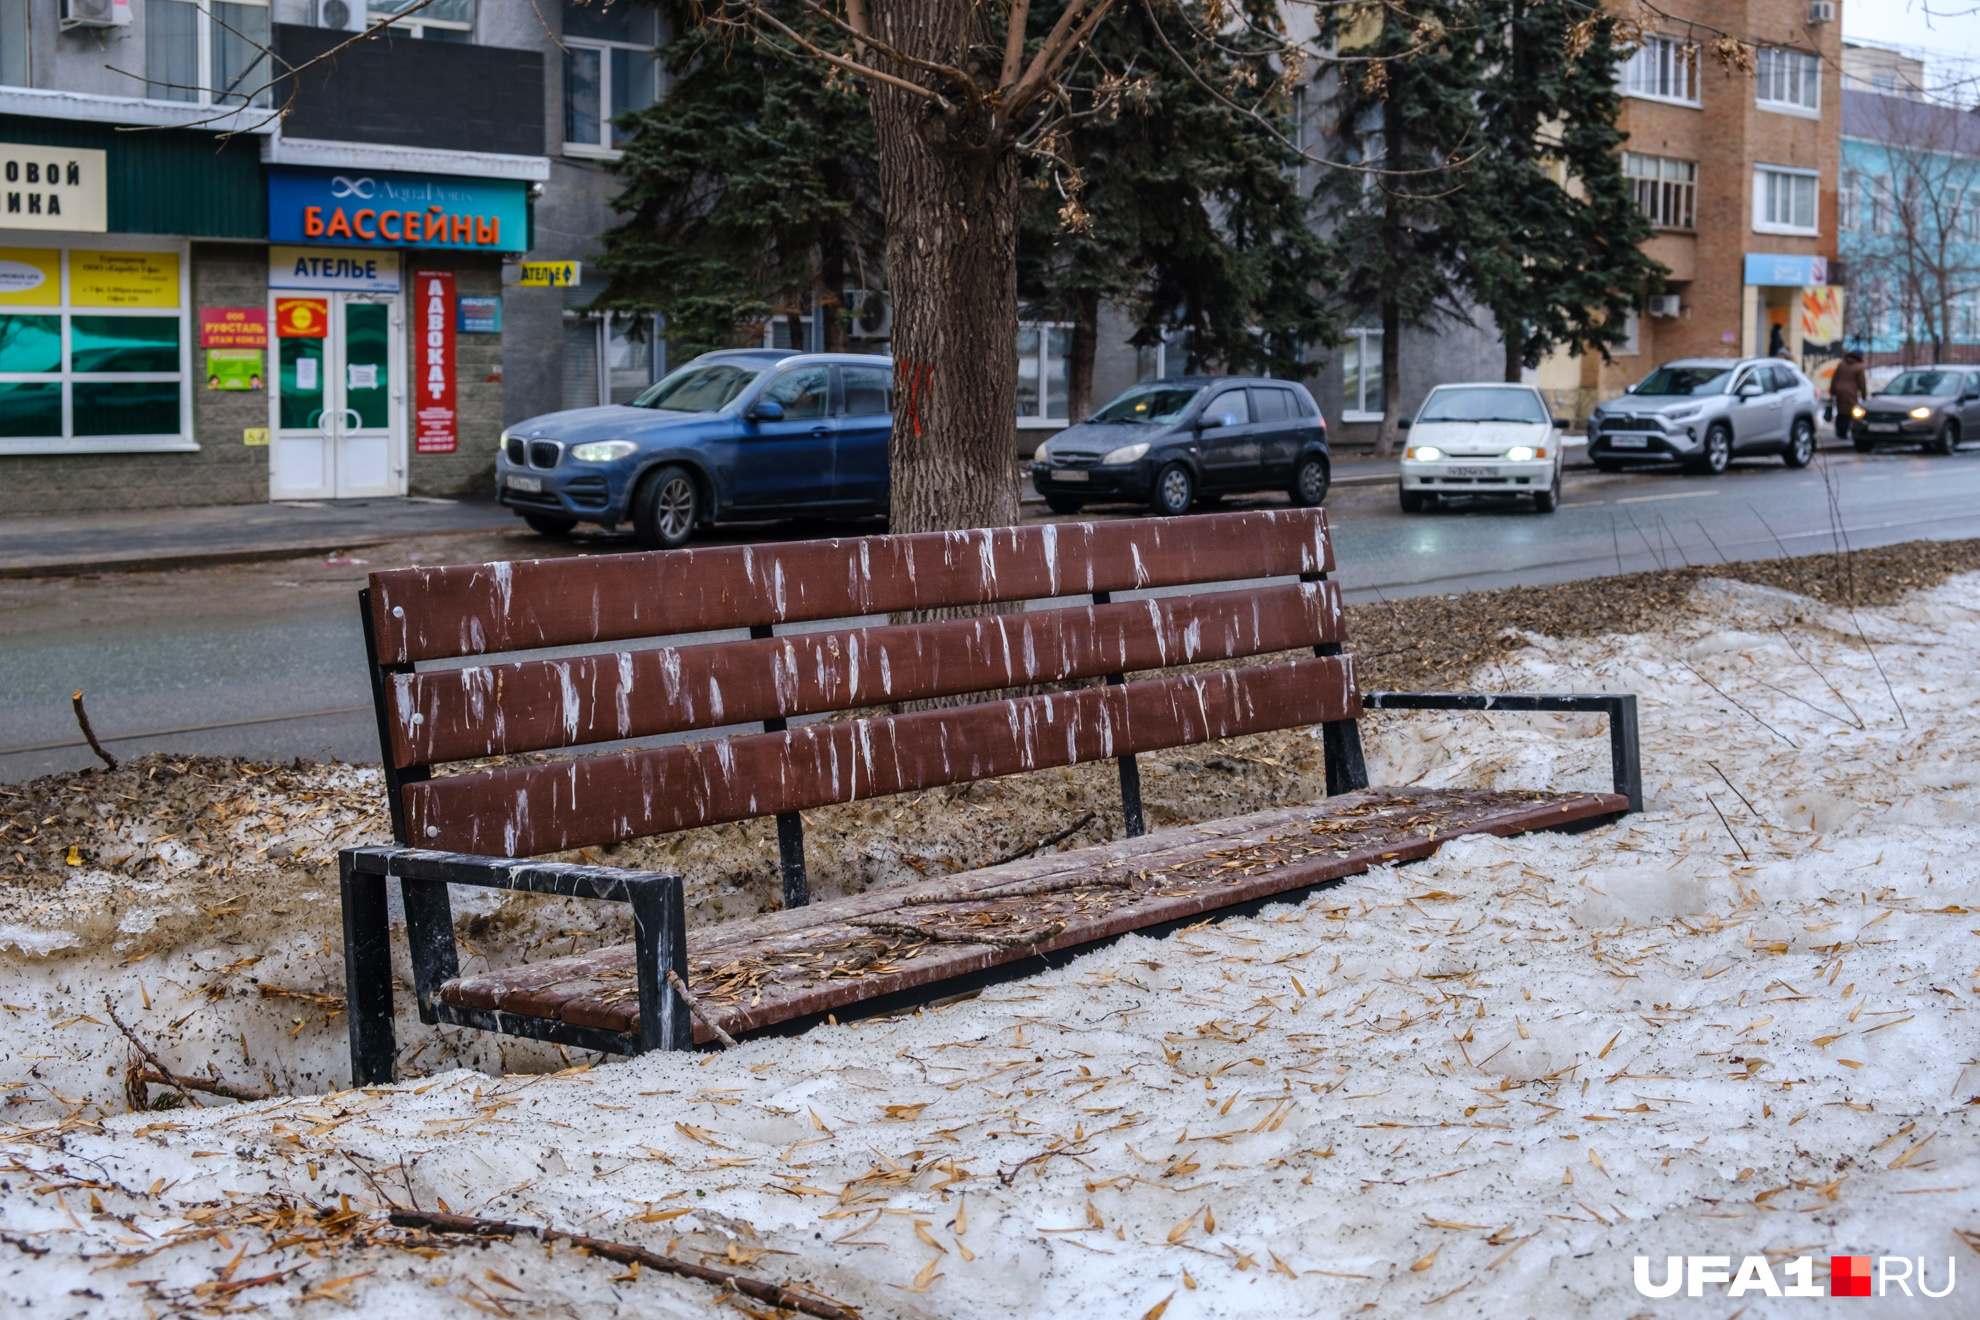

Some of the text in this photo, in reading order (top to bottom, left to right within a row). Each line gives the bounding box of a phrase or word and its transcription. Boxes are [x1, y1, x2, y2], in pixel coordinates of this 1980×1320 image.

[5, 160, 80, 186] ОВОЙ
[0, 190, 61, 215] ИКА
[303, 206, 500, 245] БАССЕЙНЫ
[293, 257, 377, 279] АТЕЛЬЕ
[521, 264, 560, 283] АТЕЛЬЕ
[427, 279, 445, 399] АДВОКАТ
